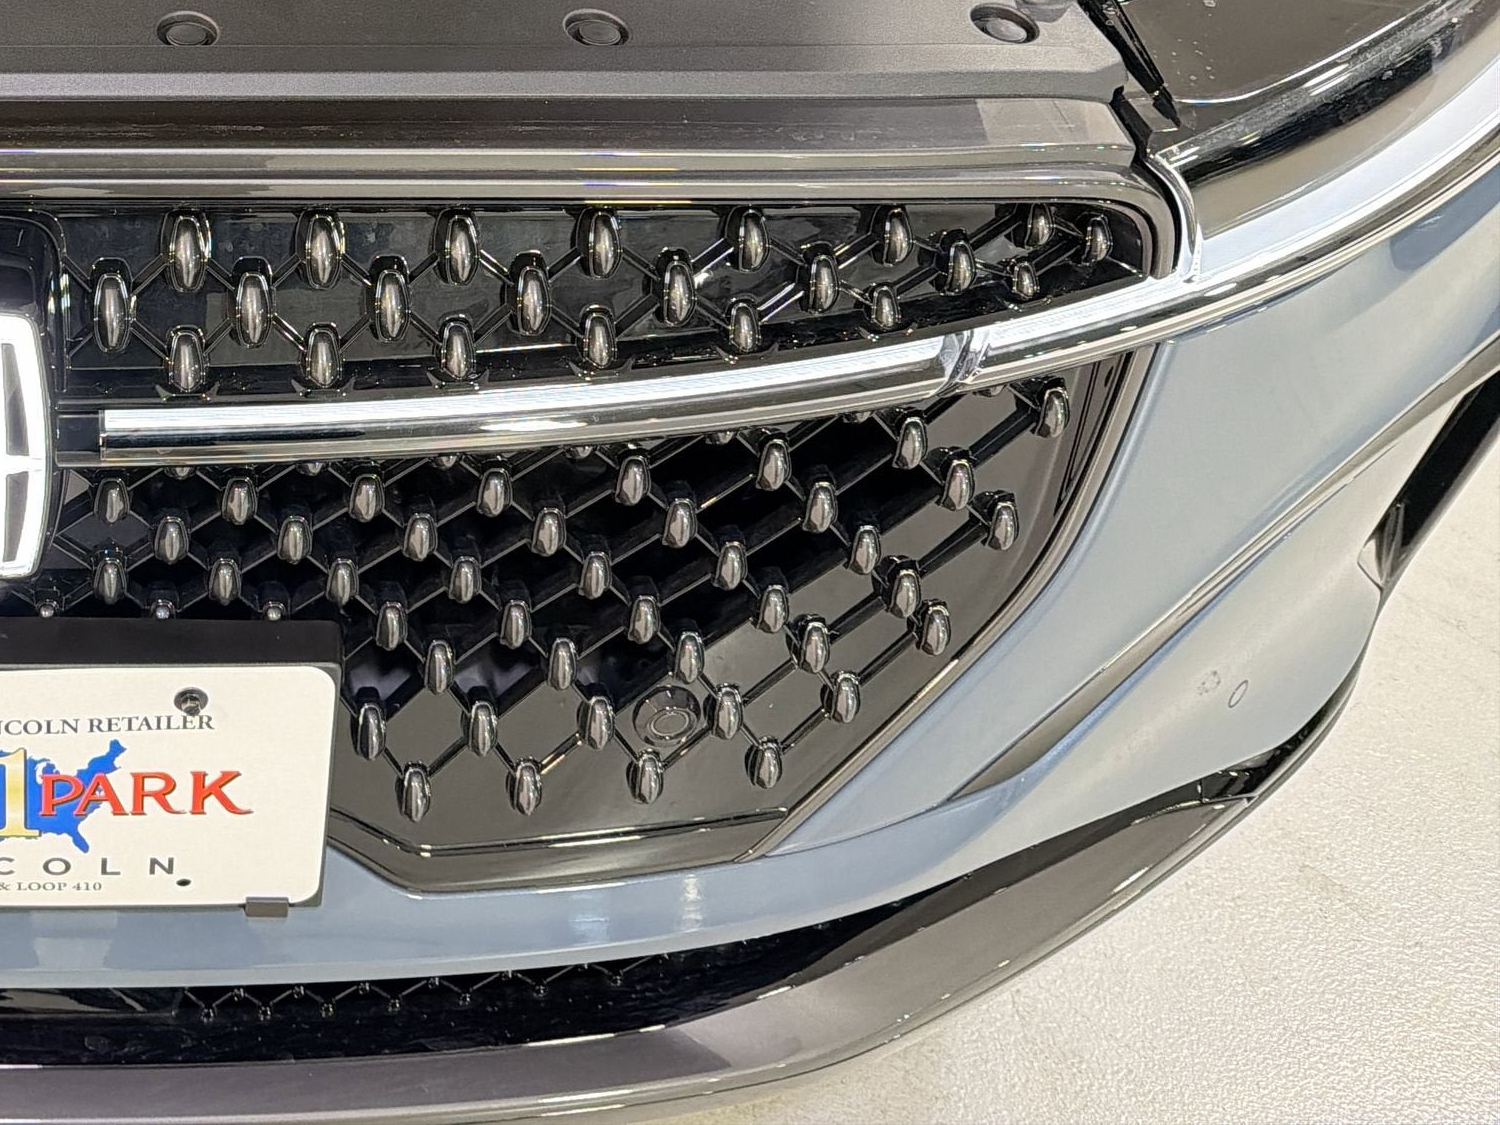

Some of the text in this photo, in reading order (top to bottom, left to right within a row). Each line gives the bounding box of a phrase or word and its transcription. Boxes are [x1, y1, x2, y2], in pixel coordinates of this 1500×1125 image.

[87, 714, 216, 733] RETAILER
[39, 769, 254, 817] PARK
[17, 881, 68, 892] LOOP
[71, 880, 104, 892] 410
